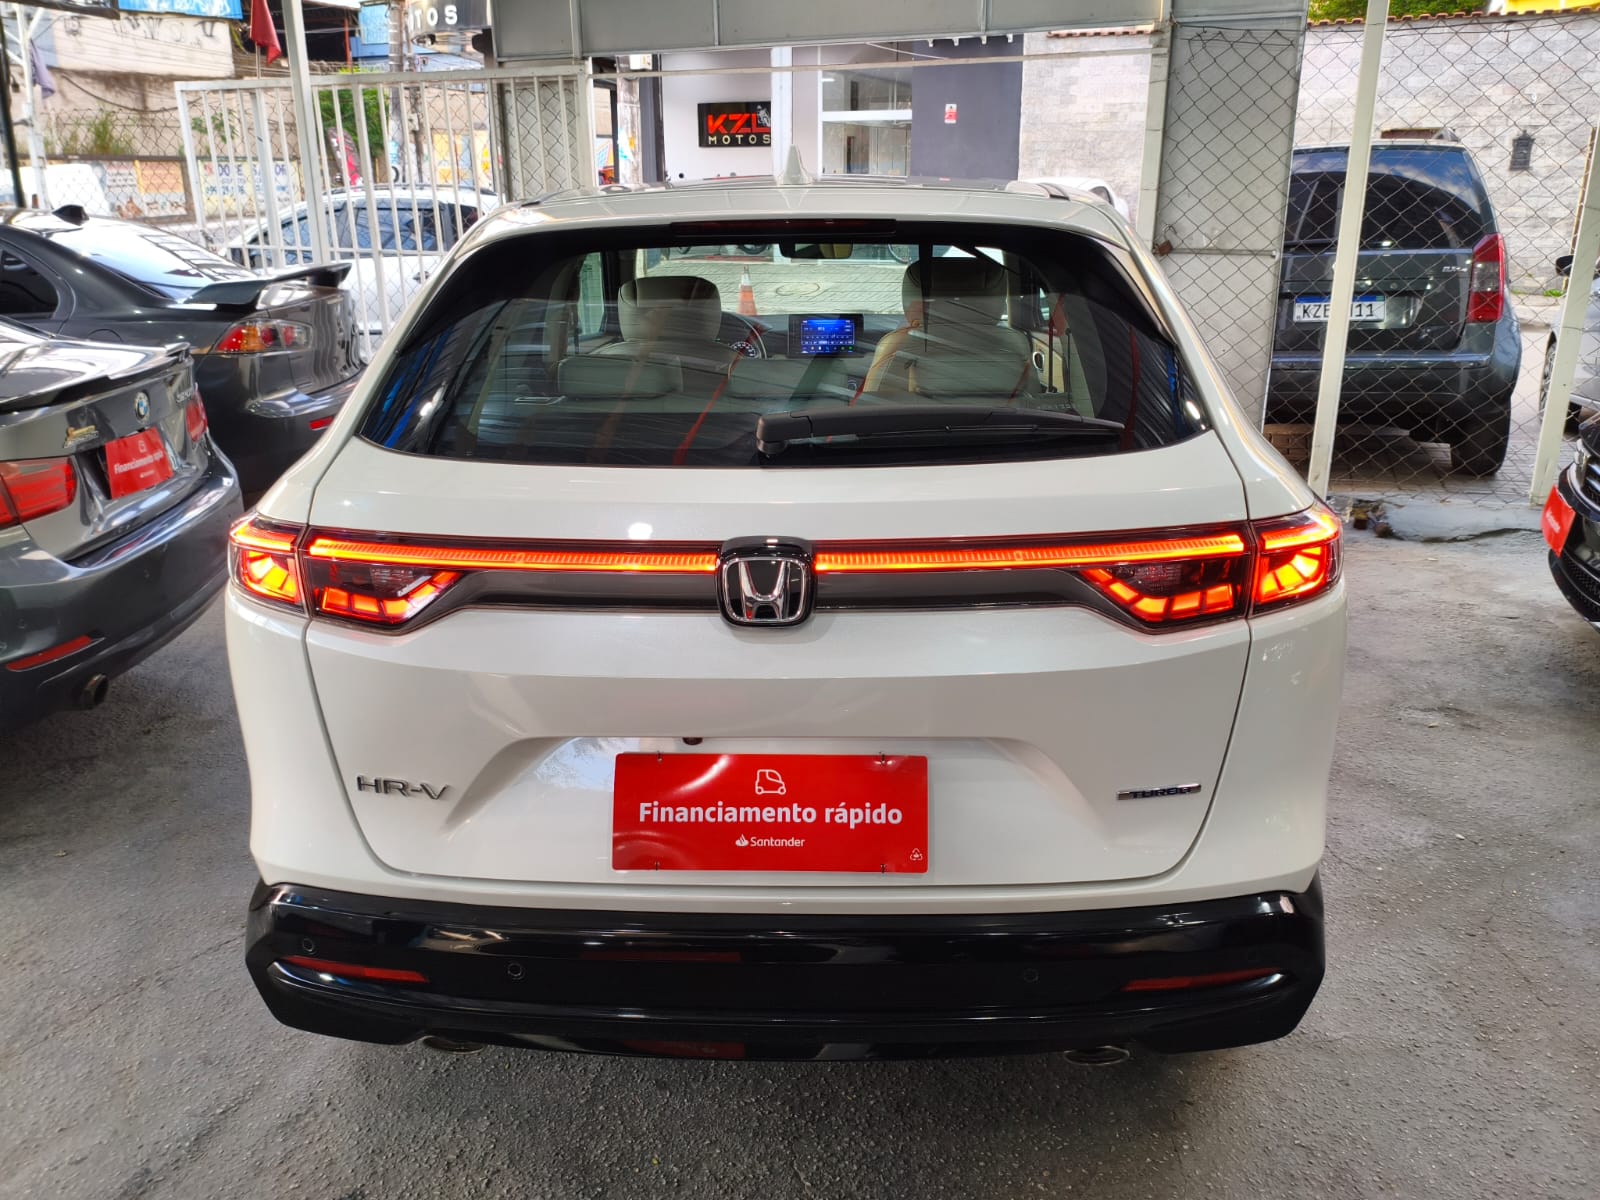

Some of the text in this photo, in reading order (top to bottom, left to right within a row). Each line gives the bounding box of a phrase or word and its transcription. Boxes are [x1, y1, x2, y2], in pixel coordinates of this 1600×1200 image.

[708, 134, 771, 145] MOTOS
[357, 776, 448, 800] HR-V
[639, 801, 903, 829] Financiamento rápido
[750, 836, 806, 848] Santander
